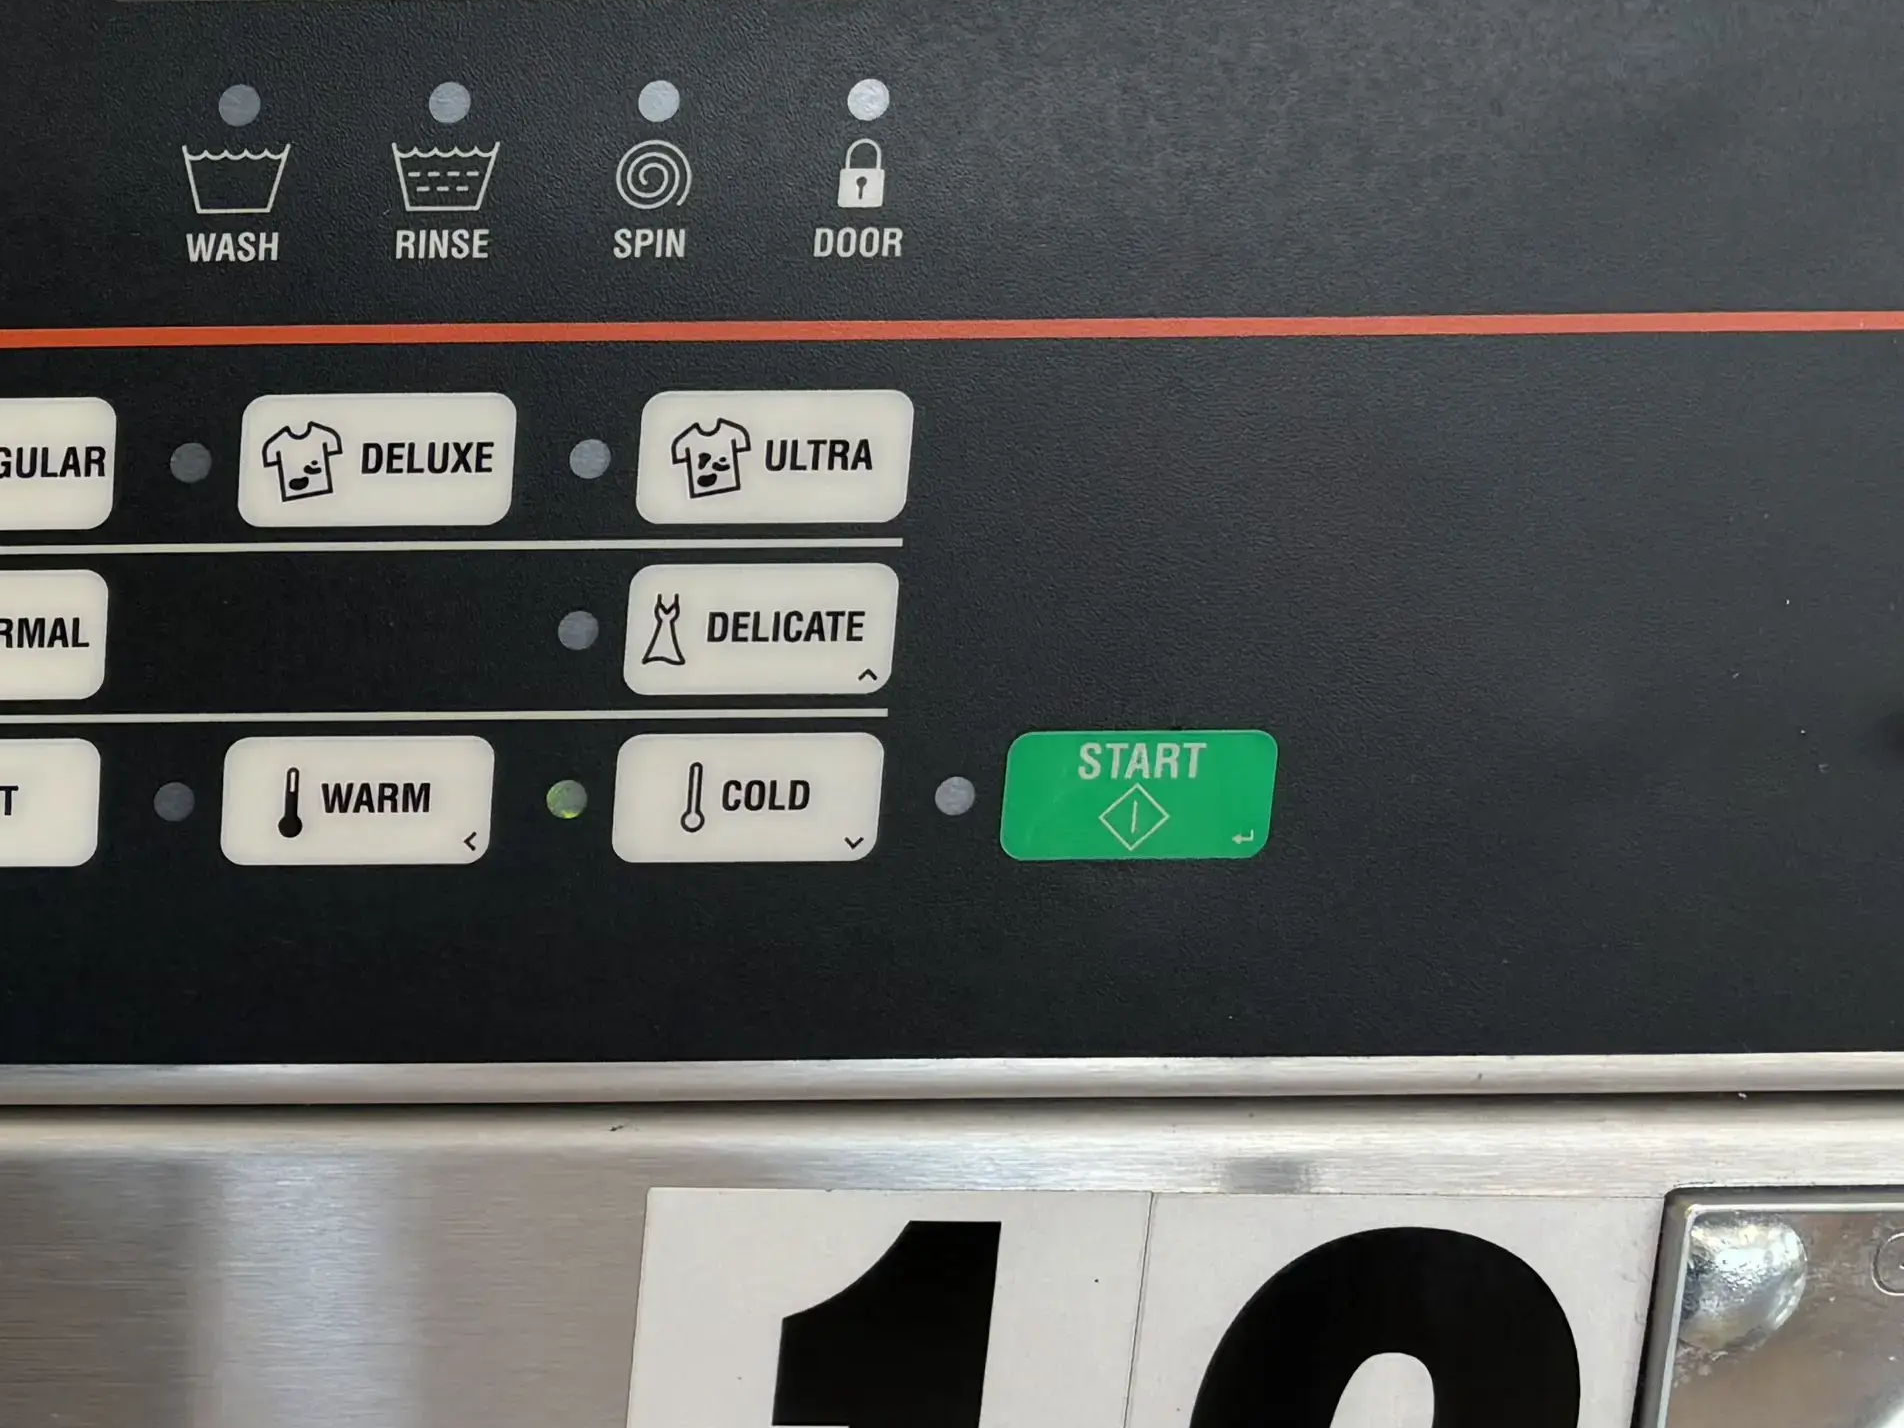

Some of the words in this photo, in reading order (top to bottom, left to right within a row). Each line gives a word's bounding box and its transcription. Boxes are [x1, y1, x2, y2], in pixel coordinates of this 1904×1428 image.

[185, 231, 279, 263] WASH
[395, 228, 490, 260] RINSE
[613, 228, 686, 259] SPIN
[813, 226, 903, 258] DOOR
[361, 441, 495, 475] DELUXE
[765, 438, 873, 472] ULTRA
[706, 610, 866, 643] DELICATE
[1078, 741, 1208, 780] START
[321, 782, 431, 814] WARM
[722, 779, 811, 812] COLD
